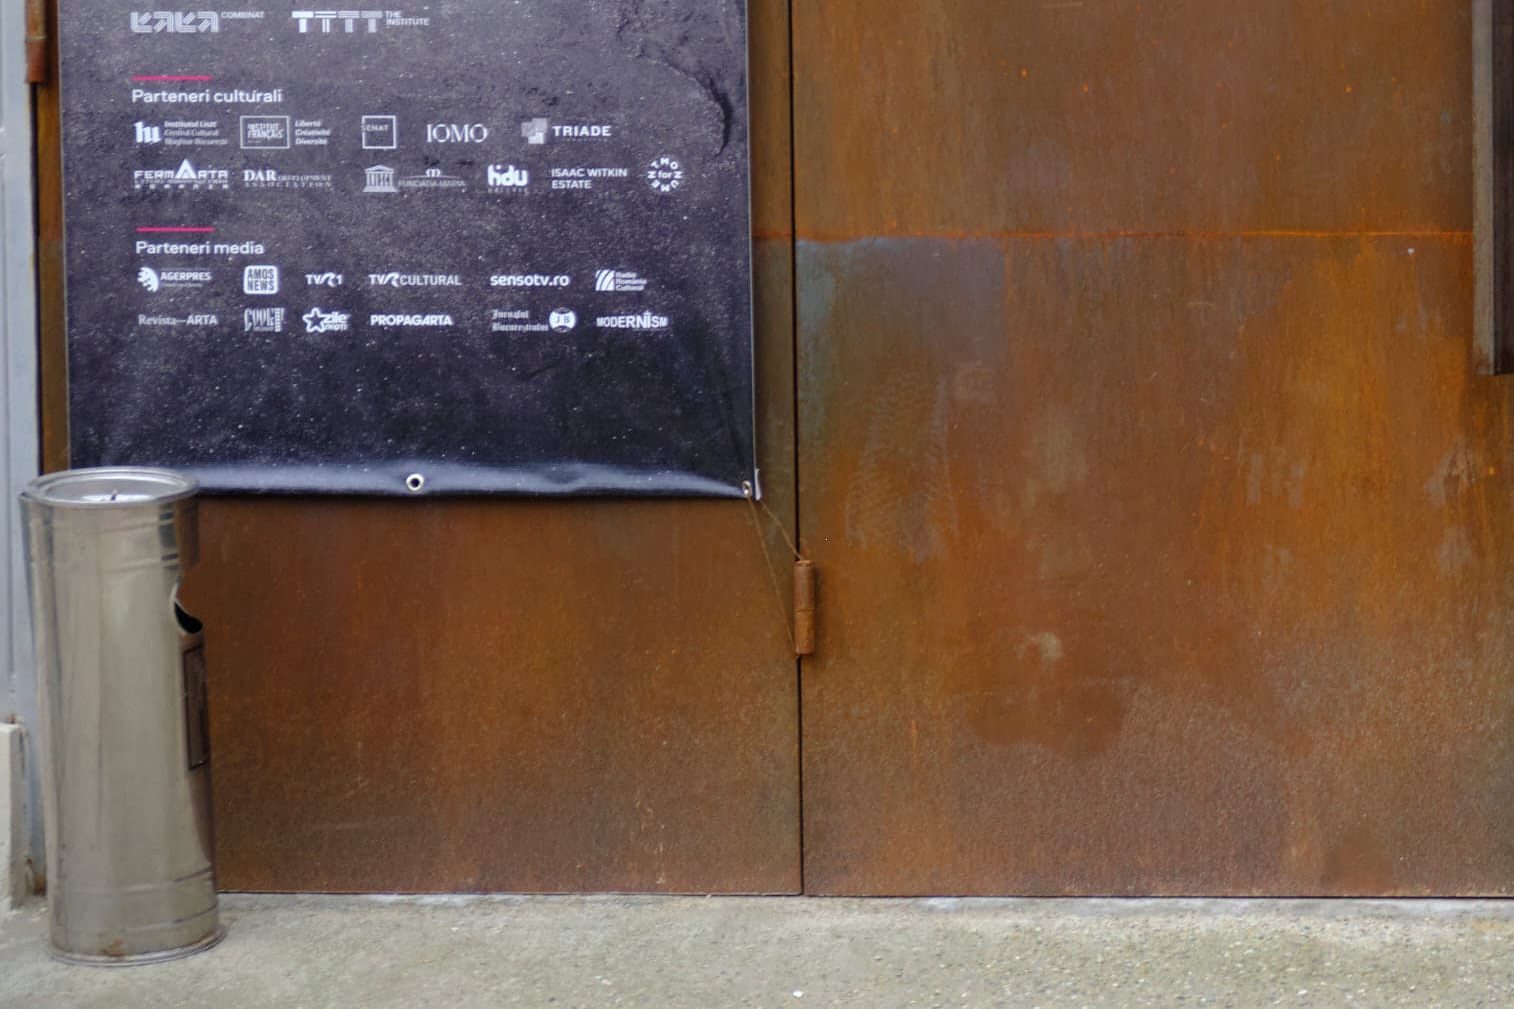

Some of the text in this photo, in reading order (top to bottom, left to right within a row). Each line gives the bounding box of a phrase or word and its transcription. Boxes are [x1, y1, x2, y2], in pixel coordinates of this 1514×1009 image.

[132, 89, 283, 103] Parteneri culturali
[426, 123, 488, 143] IOMO
[551, 125, 612, 137] TRIADE
[243, 169, 277, 182] DAR
[551, 168, 628, 177] ISAAC WITKIN
[551, 179, 592, 189] ESTATE
[135, 241, 264, 255] Parteneri media
[160, 271, 212, 282] AGERPRES
[400, 274, 463, 286] CULTURAL
[489, 274, 570, 286] sensotv.ro
[370, 314, 453, 327] PROPAGARTA
[596, 310, 668, 328] MODERNISM
